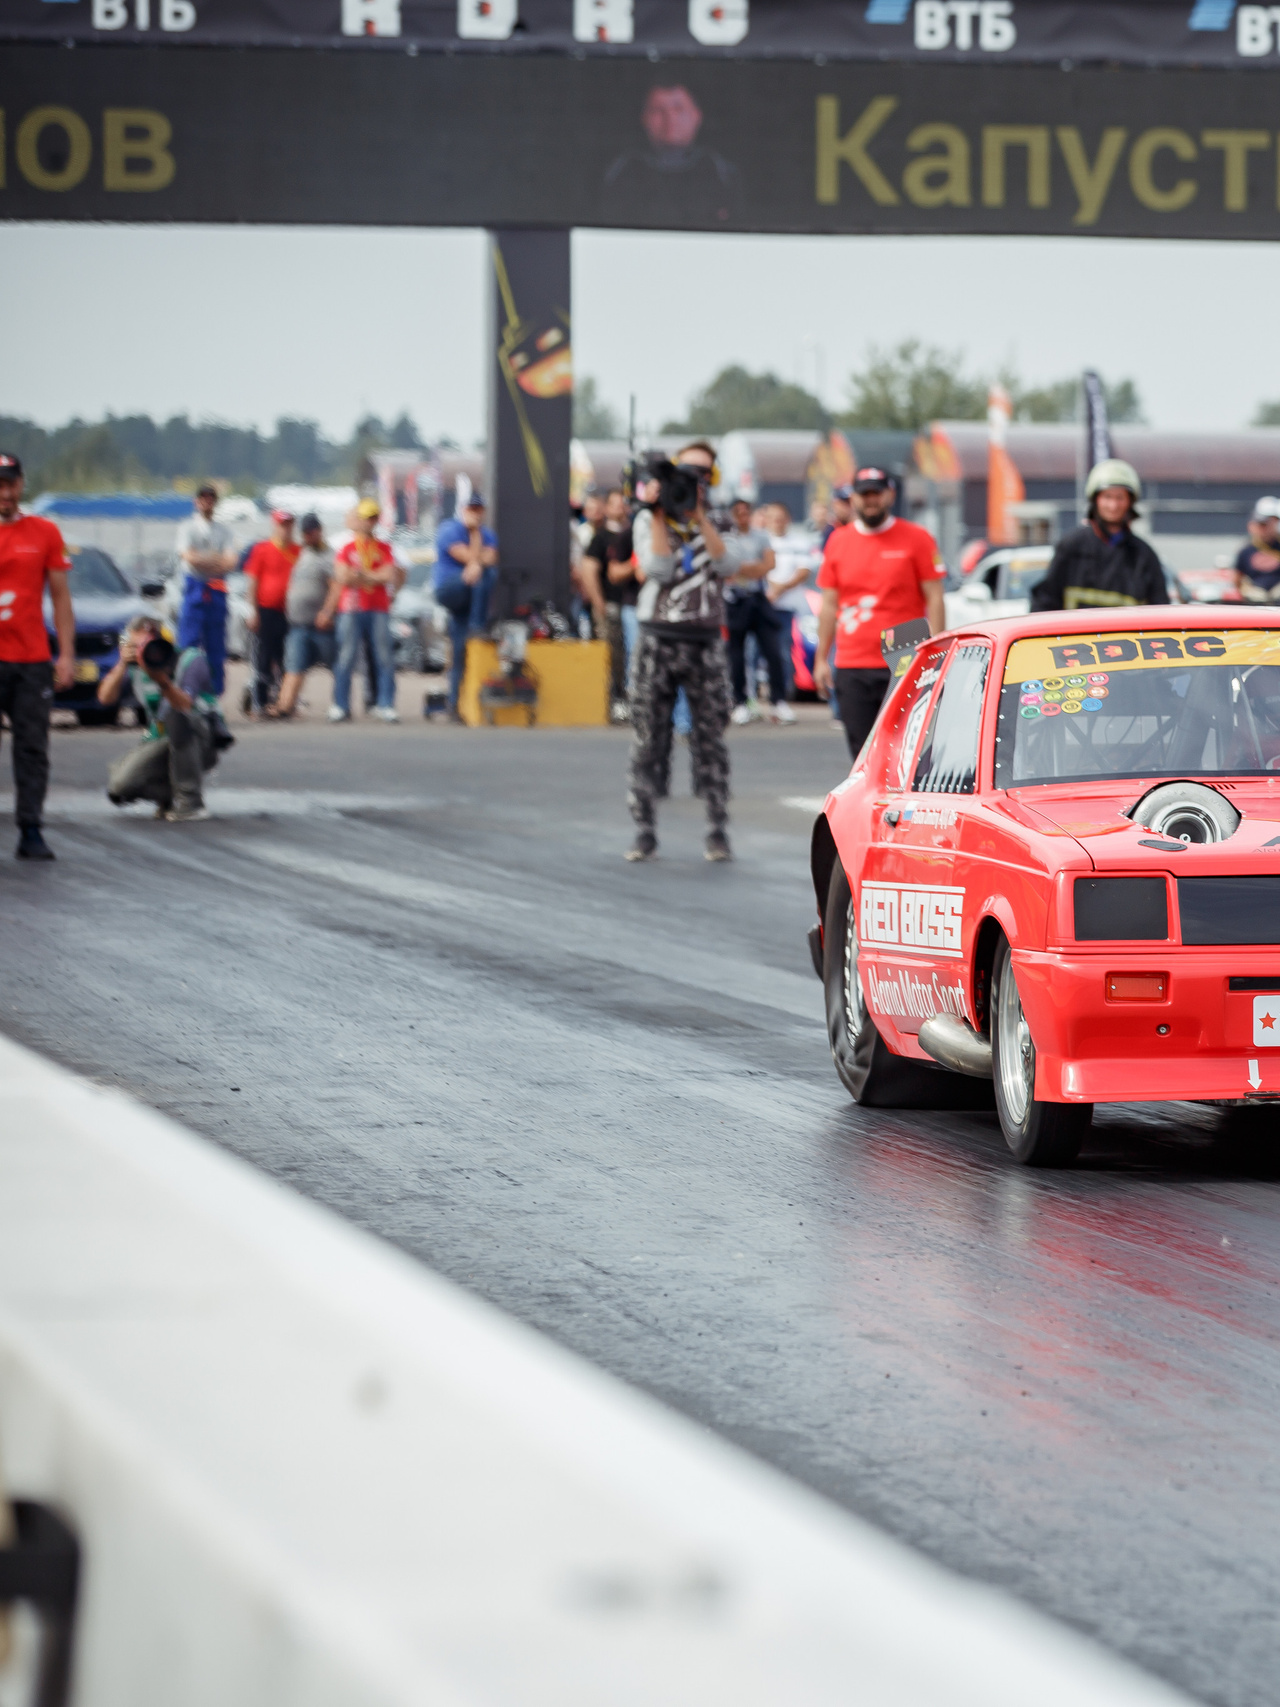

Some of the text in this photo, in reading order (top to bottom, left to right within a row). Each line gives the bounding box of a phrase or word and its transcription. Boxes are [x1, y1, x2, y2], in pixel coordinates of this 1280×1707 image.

[913, 0, 1017, 51] ВТБ
[1048, 636, 1227, 669] RDRC
[861, 888, 963, 949] RED BOSS
